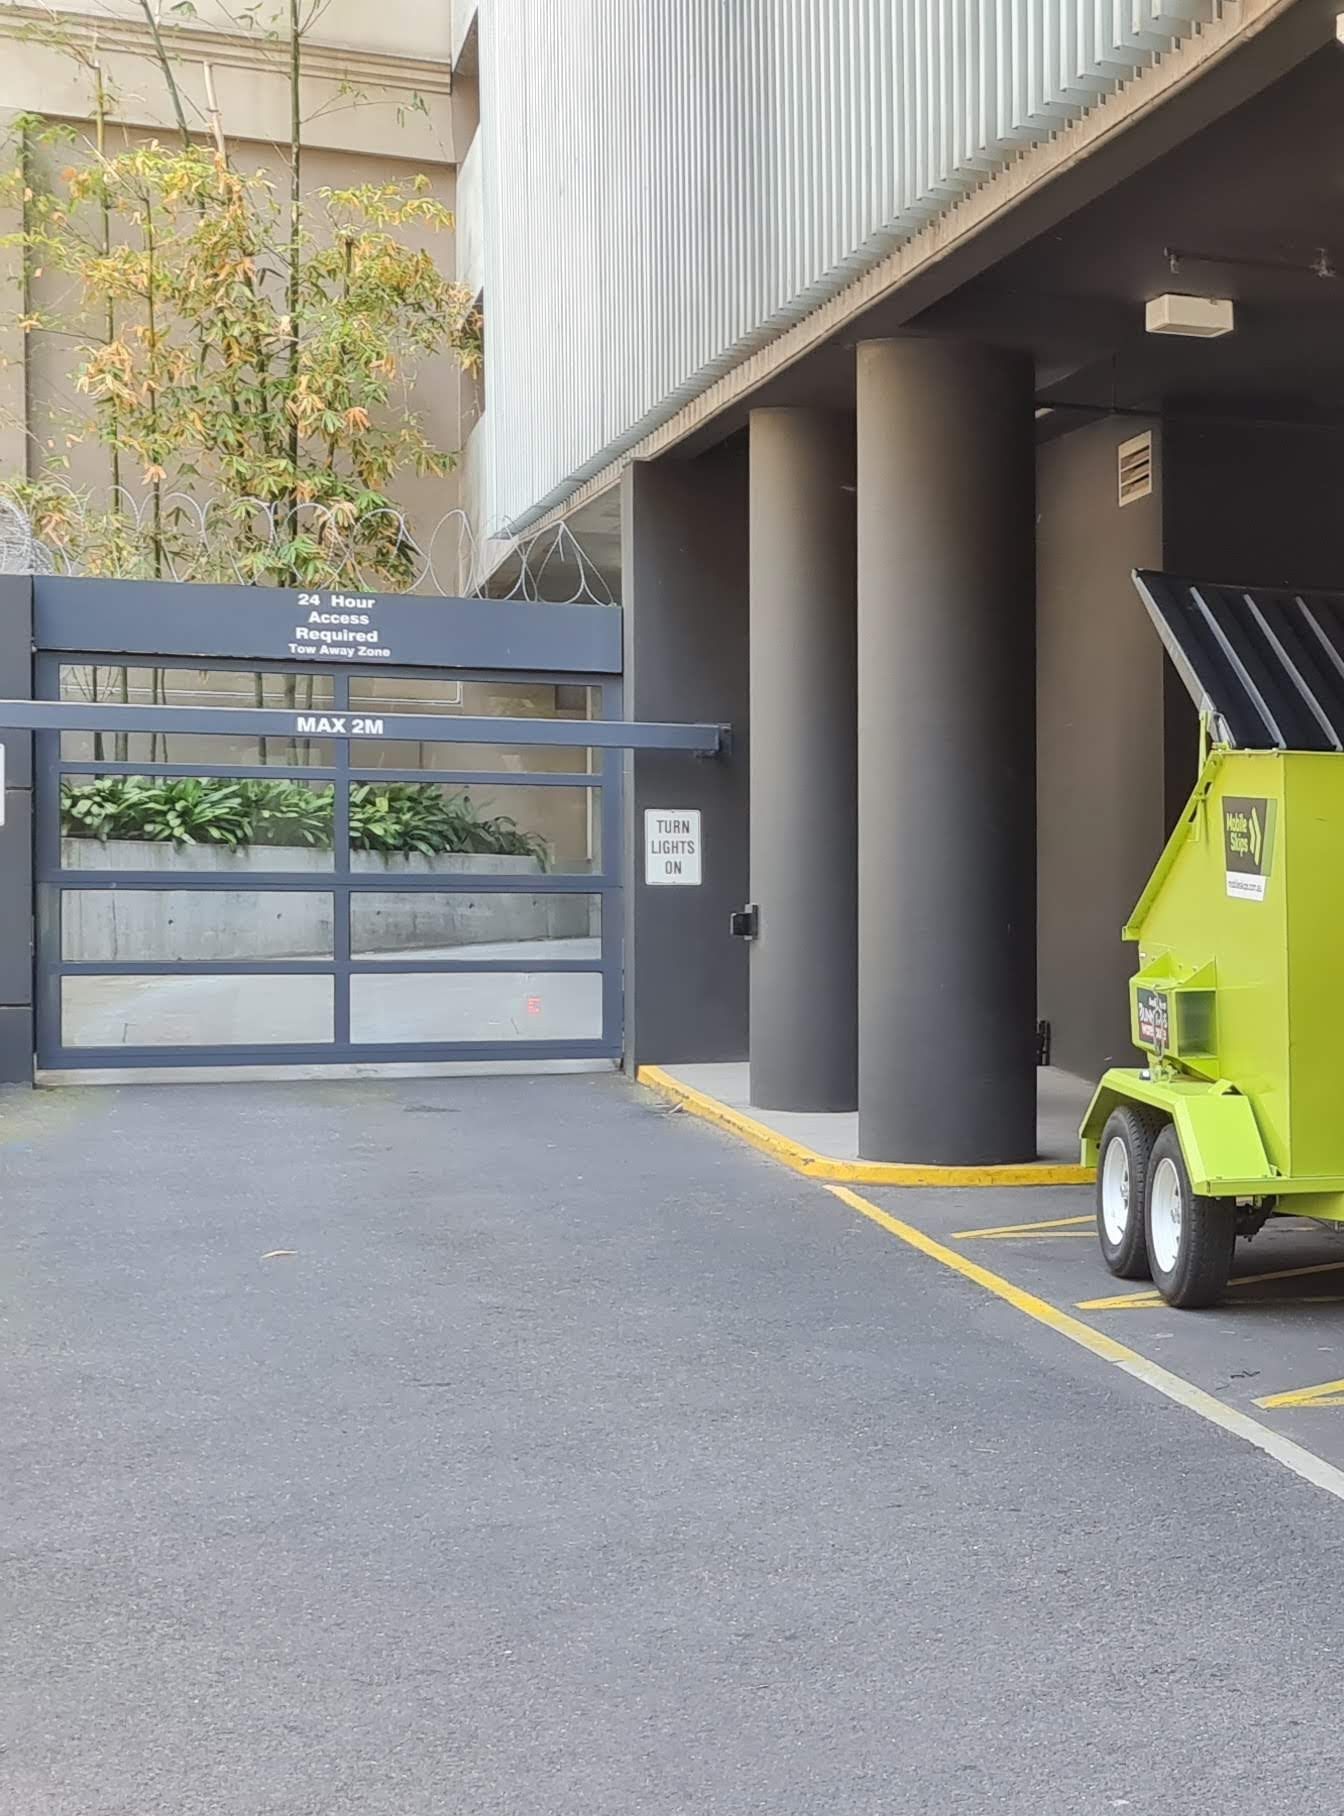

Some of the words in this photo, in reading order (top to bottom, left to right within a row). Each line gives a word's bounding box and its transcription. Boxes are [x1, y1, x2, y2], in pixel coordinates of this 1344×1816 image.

[298, 593, 320, 606] 24
[331, 595, 376, 608] Hour
[308, 611, 369, 625] Access
[295, 627, 378, 643] Required
[288, 643, 316, 654] Tow
[319, 645, 355, 658] Away
[357, 646, 391, 657] Zone
[297, 717, 346, 733] MAX
[352, 718, 384, 735] 2M
[656, 820, 690, 834] TURN
[1226, 812, 1248, 833] Mobile
[651, 840, 695, 854] LIGHTS
[1230, 832, 1249, 857] Skips
[665, 860, 682, 874] ON
